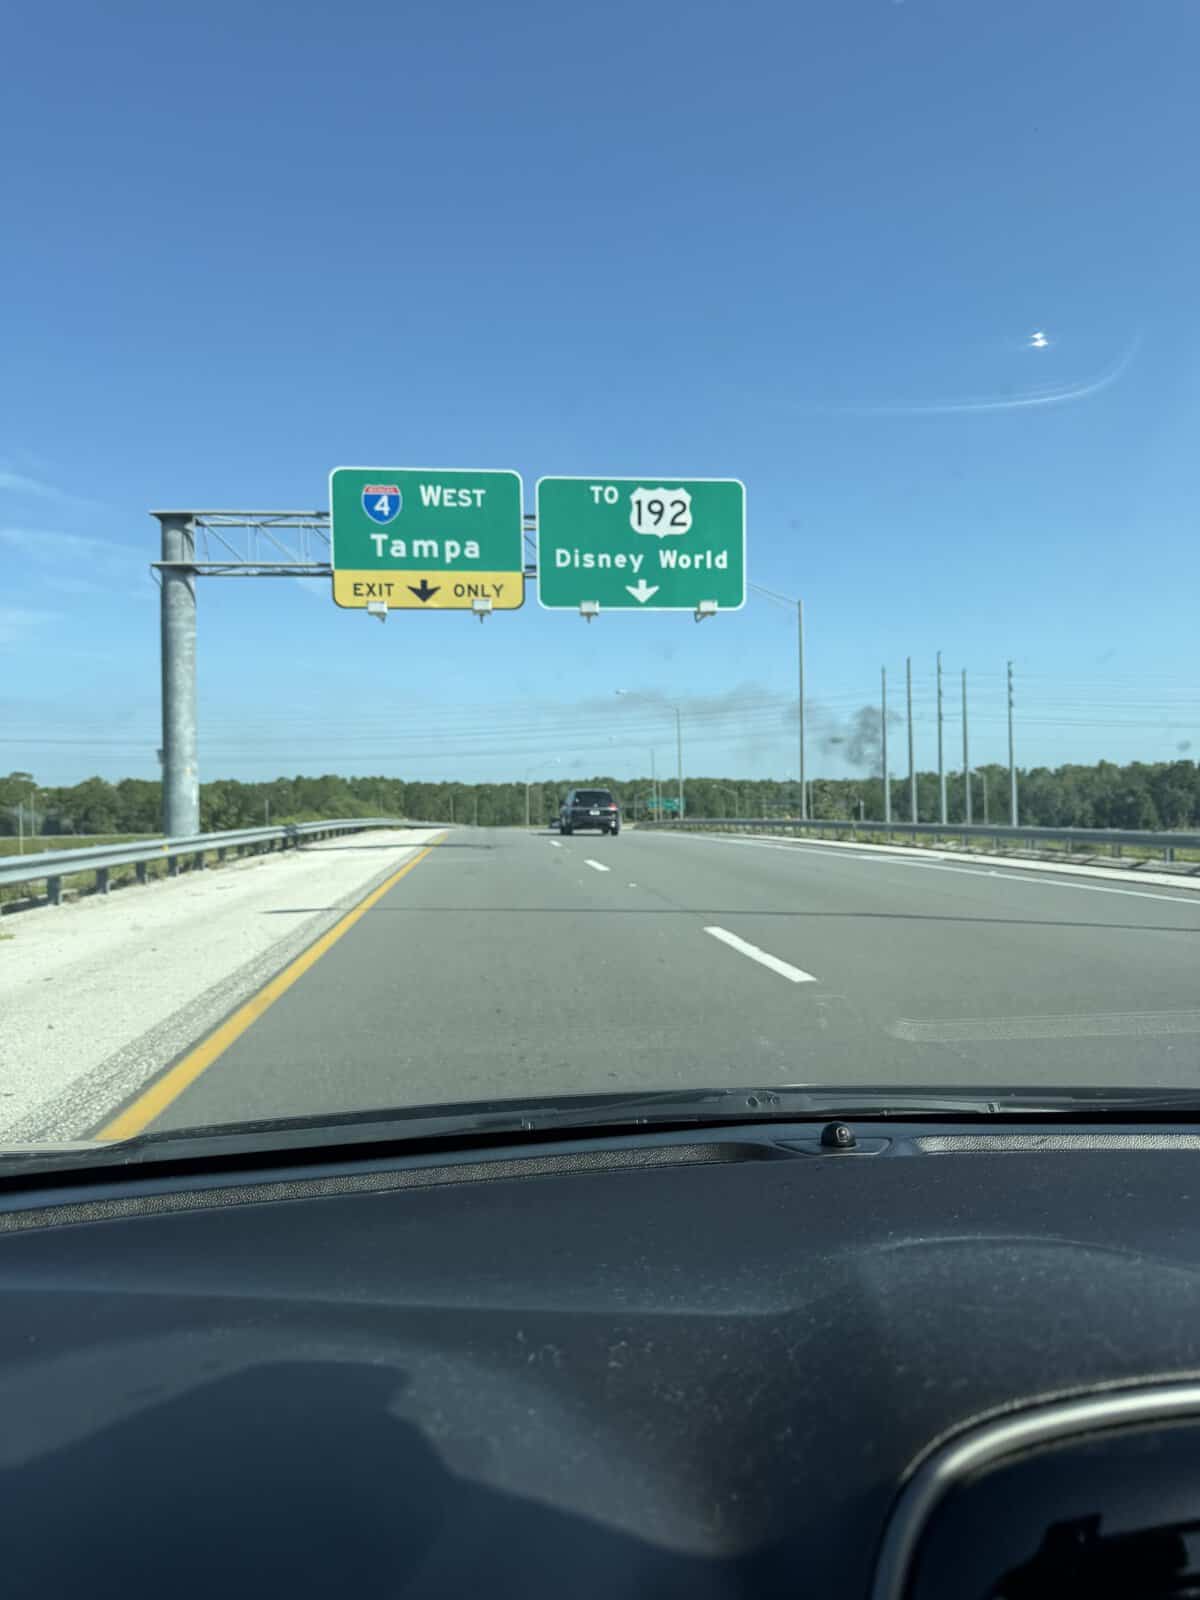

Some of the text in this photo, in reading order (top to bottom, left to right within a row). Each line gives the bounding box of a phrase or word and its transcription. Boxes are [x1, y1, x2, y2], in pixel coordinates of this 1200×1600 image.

[373, 484, 486, 516] 4 WEST
[589, 485, 687, 527] TO 192
[370, 533, 480, 564] Tampa
[555, 548, 728, 573] Disney World
[353, 583, 504, 598] EXIT ONLY
